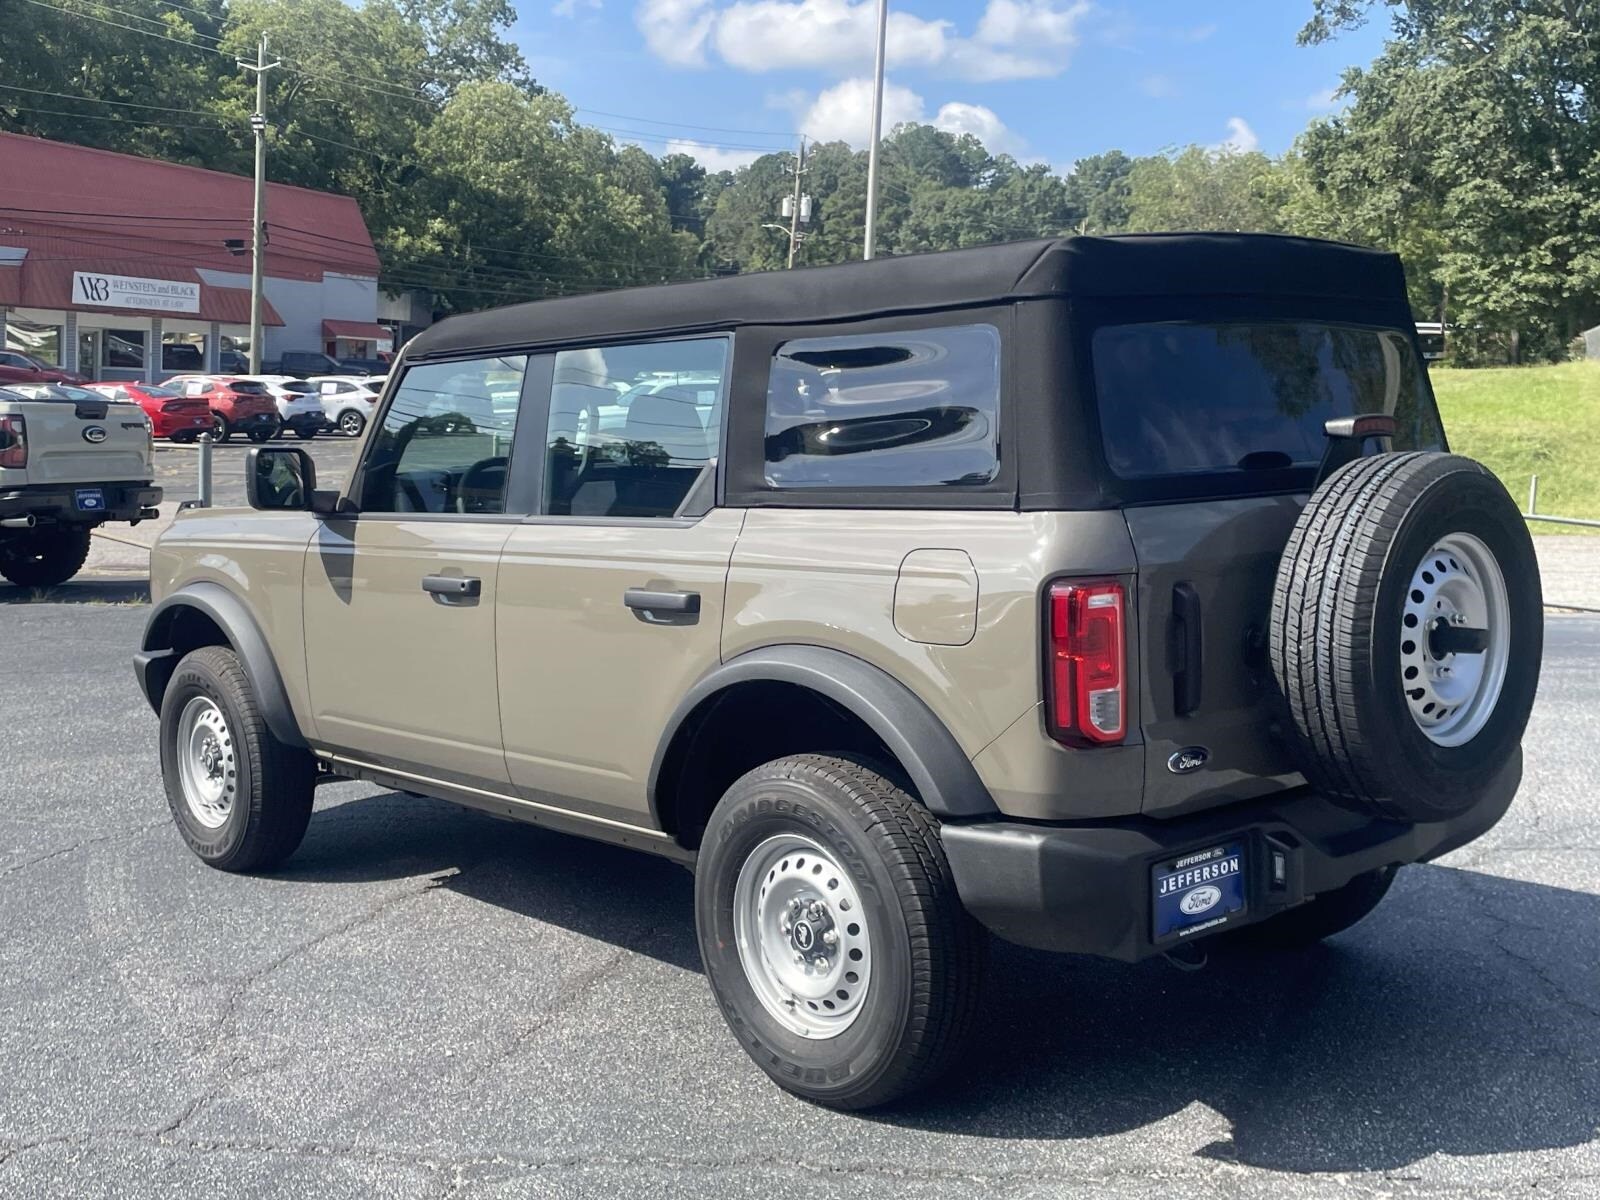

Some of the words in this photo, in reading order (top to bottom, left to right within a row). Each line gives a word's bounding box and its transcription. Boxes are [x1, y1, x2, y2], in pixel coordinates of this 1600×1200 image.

[171, 285, 196, 297] BLACK
[1176, 852, 1211, 868] JEFFERSON
[1160, 858, 1239, 894] JEFFERSON
[1188, 891, 1213, 910] Ford
